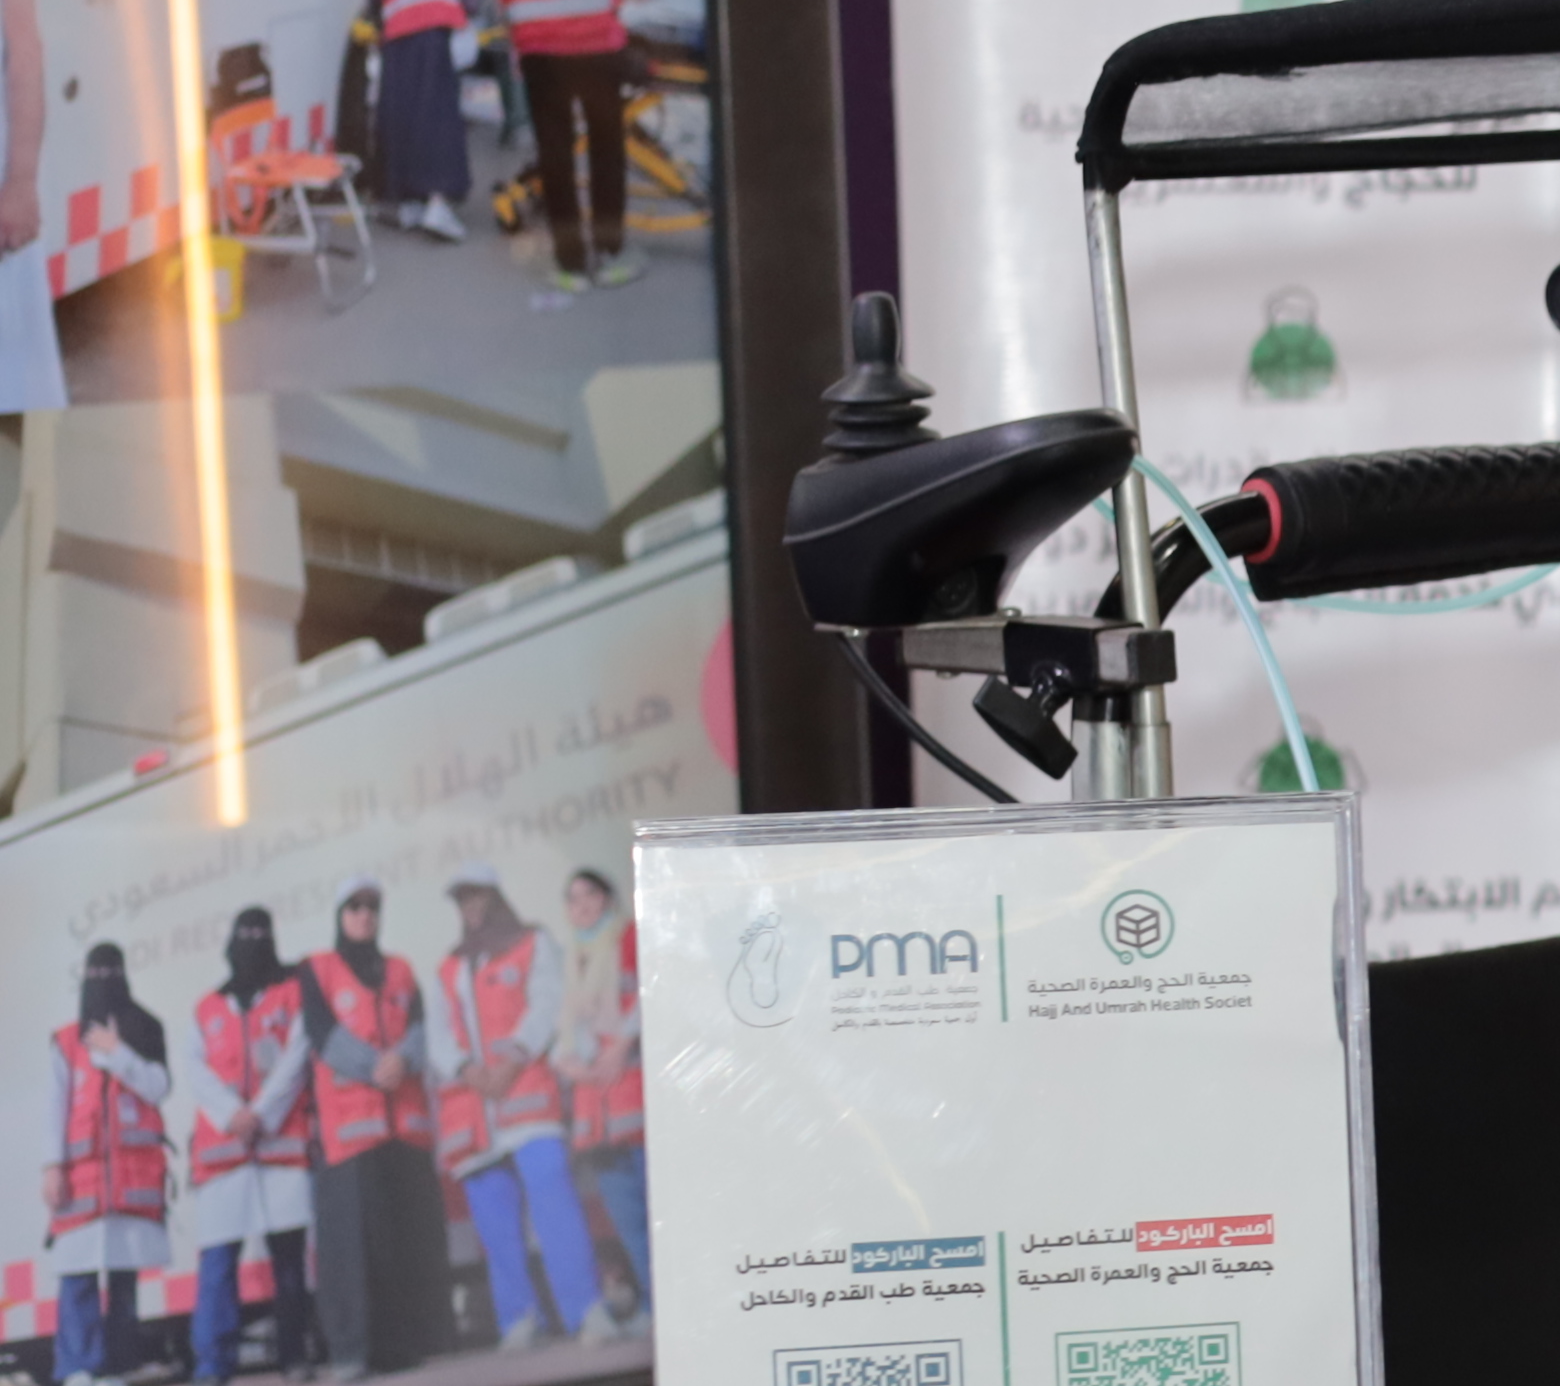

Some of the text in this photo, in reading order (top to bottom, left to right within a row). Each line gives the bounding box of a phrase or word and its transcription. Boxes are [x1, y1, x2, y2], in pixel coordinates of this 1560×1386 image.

[830, 929, 979, 979] PMA
[1027, 970, 1253, 998] جمعية الحج والعمرة الصحية
[1028, 994, 1253, 1021] Hajj And Umrah Health Societ
[1020, 1217, 1273, 1254] امسح الباركود للتفاصيل
[735, 1238, 985, 1276] امسح الباركود للتفاصيل
[1016, 1256, 1275, 1289] جمعية الحج والعمرة الصحية
[740, 1279, 986, 1313] جمعية طب القدم والكاحل
